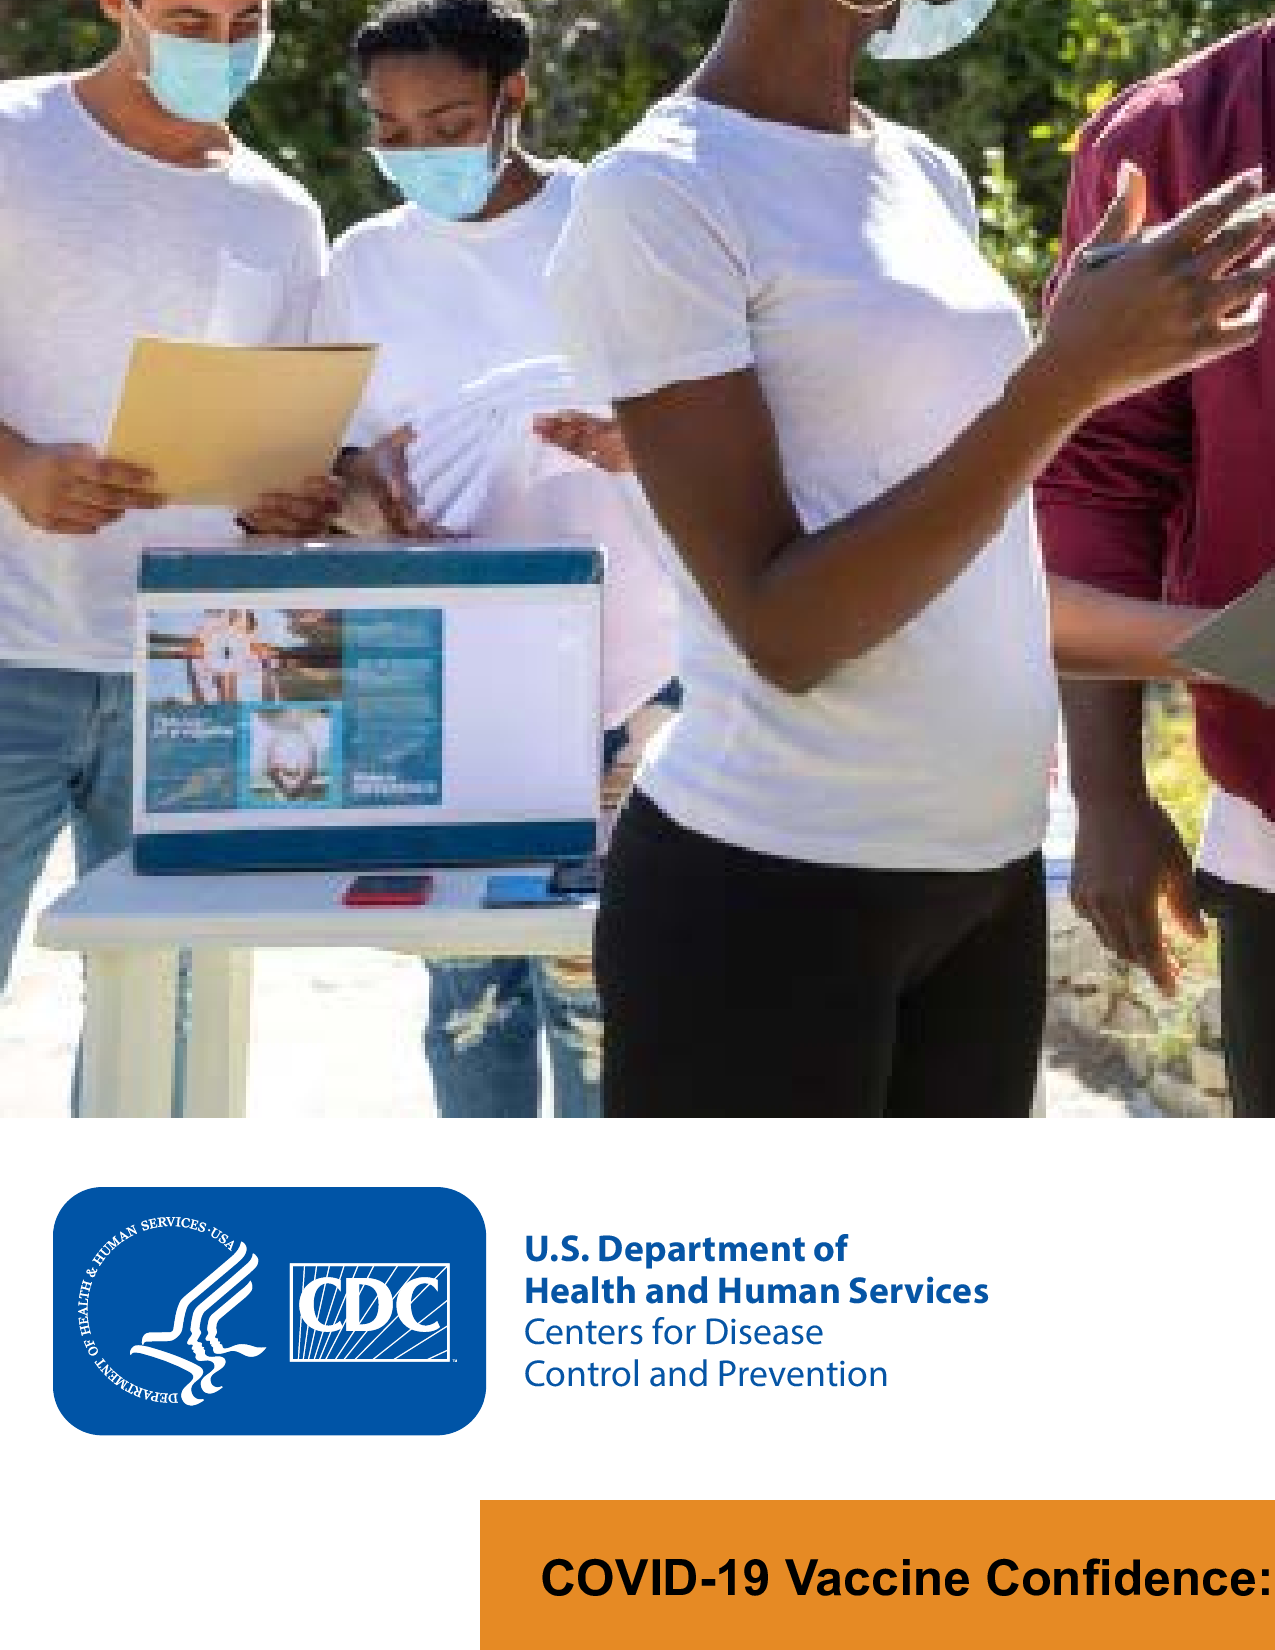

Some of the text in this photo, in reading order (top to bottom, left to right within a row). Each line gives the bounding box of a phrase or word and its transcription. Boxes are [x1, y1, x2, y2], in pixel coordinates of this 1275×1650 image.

[526, 1233, 850, 1269] U.S. Department of
[77, 1278, 93, 1337] HEALTH
[91, 1224, 138, 1267] HUMAN
[526, 1276, 989, 1304] Health and Human Services
[299, 1276, 441, 1333] CDC
[525, 1317, 824, 1346] Centers for Disease
[525, 1359, 888, 1387] Control and Prevention
[542, 1558, 769, 1597] COVID-19
[785, 1558, 970, 1597] Vaccine
[987, 1558, 1270, 1597] Confidence:
